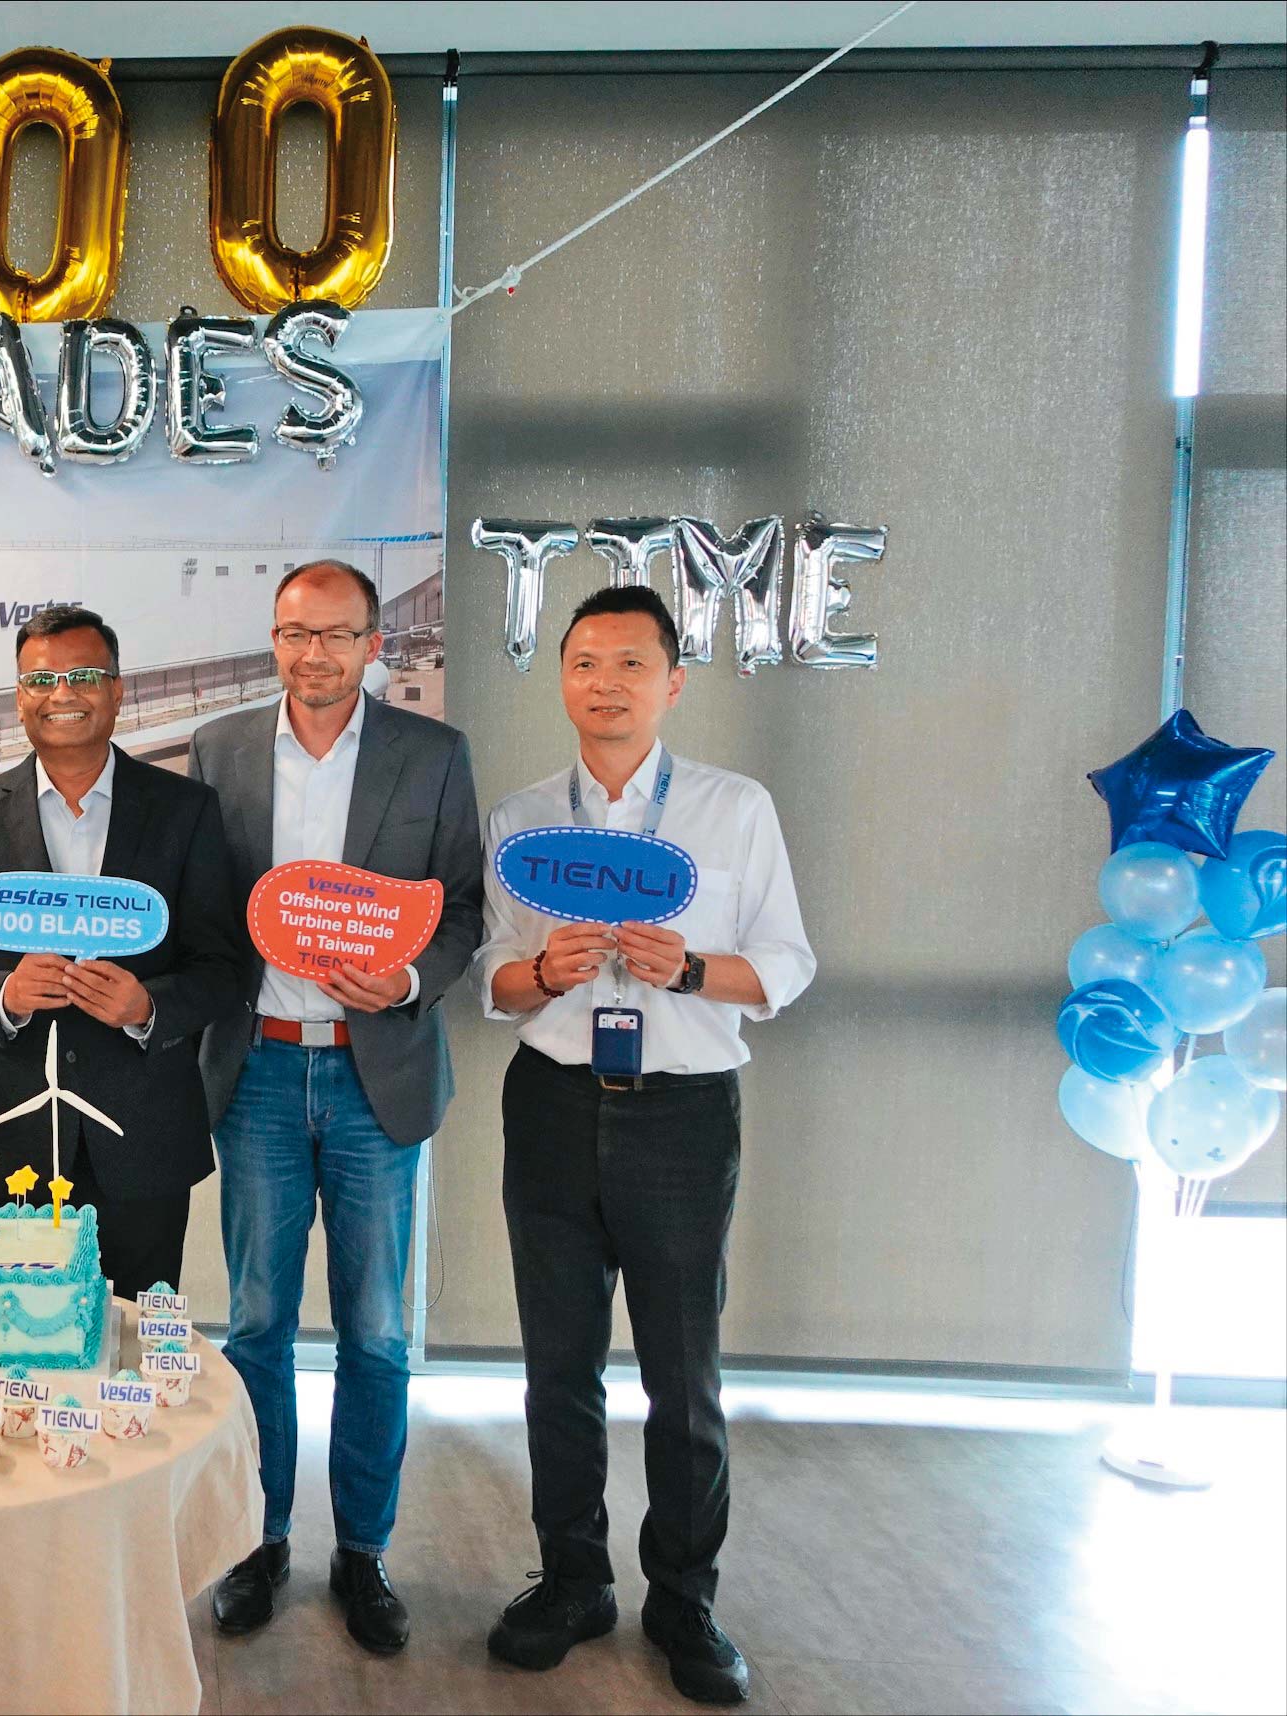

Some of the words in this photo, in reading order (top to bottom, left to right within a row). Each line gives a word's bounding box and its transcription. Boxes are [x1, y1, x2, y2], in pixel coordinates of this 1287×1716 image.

[308, 877, 377, 898] Vestas
[521, 856, 678, 898] TIENLI
[75, 894, 152, 912] TIENLI
[279, 891, 352, 914] Offshore
[355, 902, 401, 921] Wind
[40, 914, 142, 939] BLADES
[279, 910, 342, 932] Turbine
[346, 920, 395, 940] Blade
[296, 932, 311, 947] in
[317, 935, 375, 956] Taiwan
[139, 1294, 186, 1310] TIENLI
[140, 1321, 187, 1337] Vestas
[145, 1355, 197, 1371] TIENLI
[100, 1382, 152, 1402] Vestas
[42, 1409, 98, 1430] TIENLI
